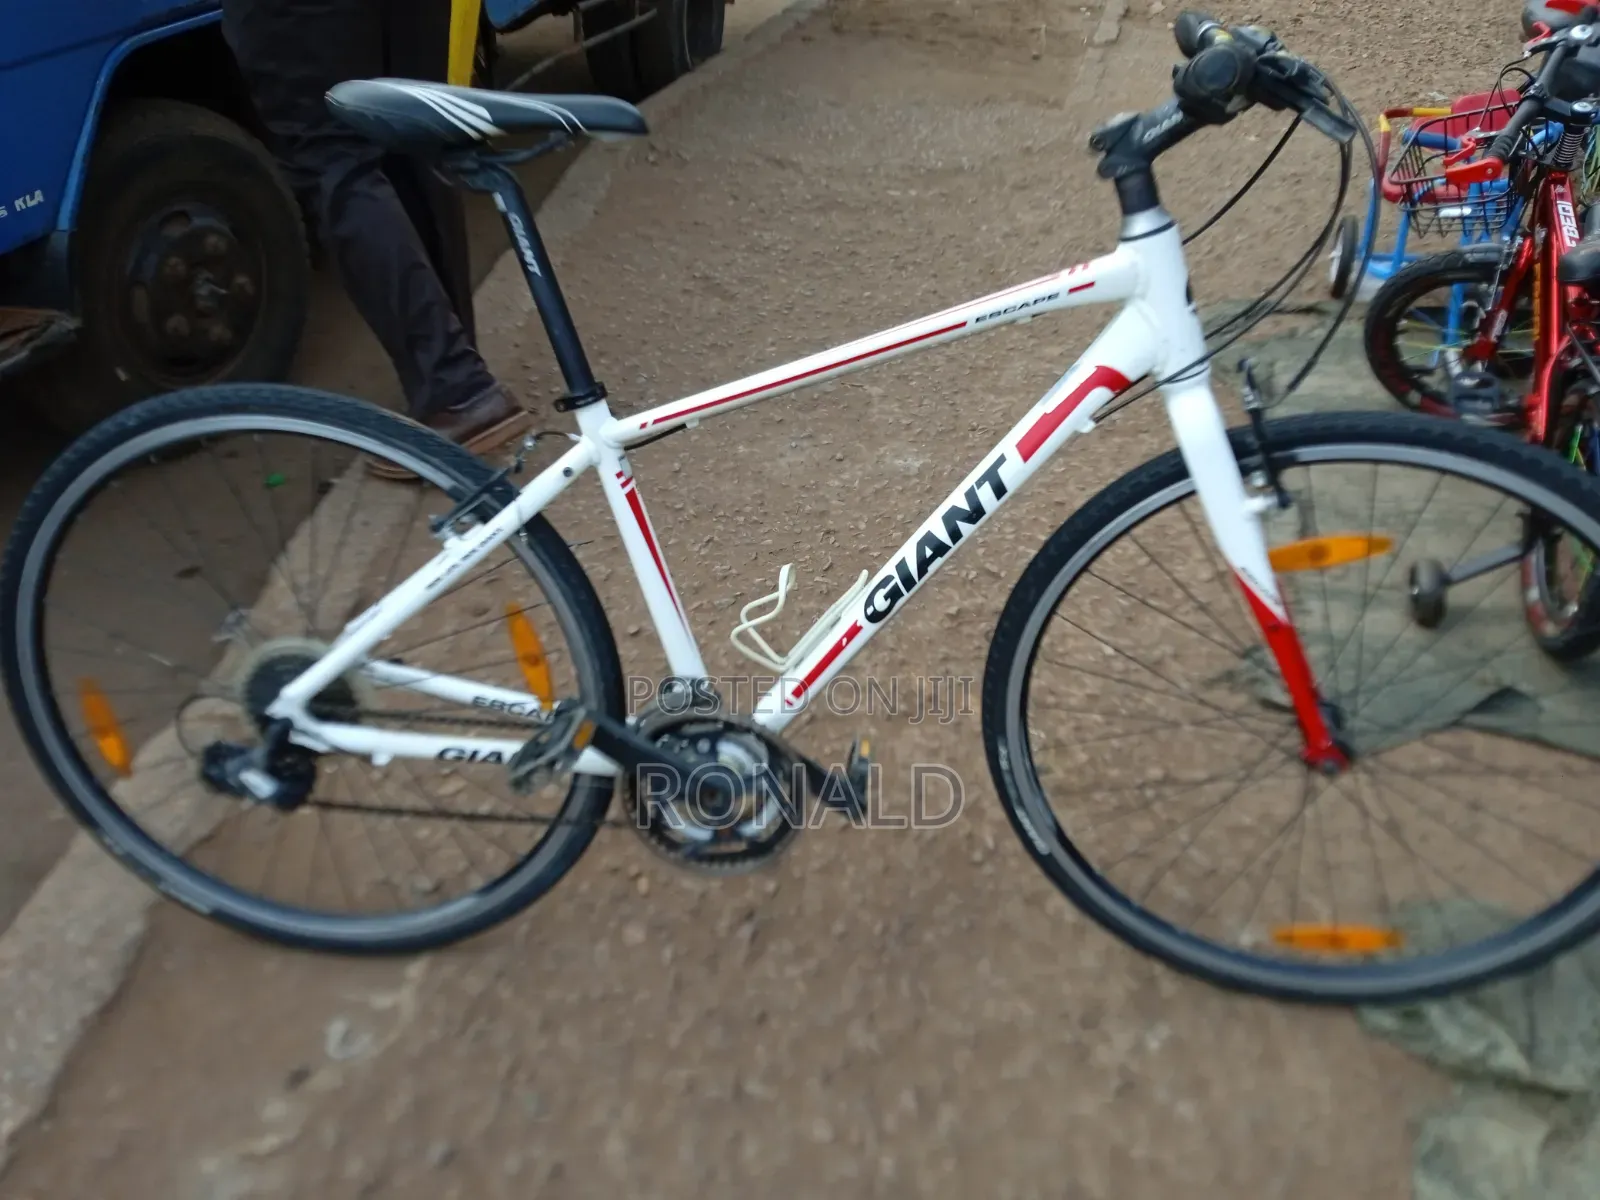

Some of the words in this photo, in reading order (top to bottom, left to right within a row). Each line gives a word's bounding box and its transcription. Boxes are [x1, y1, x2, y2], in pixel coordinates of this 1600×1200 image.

[14, 189, 44, 212] KLA
[974, 292, 1060, 324] ESCAPE
[863, 452, 1009, 624] GIANT
[436, 747, 504, 764] GIA
